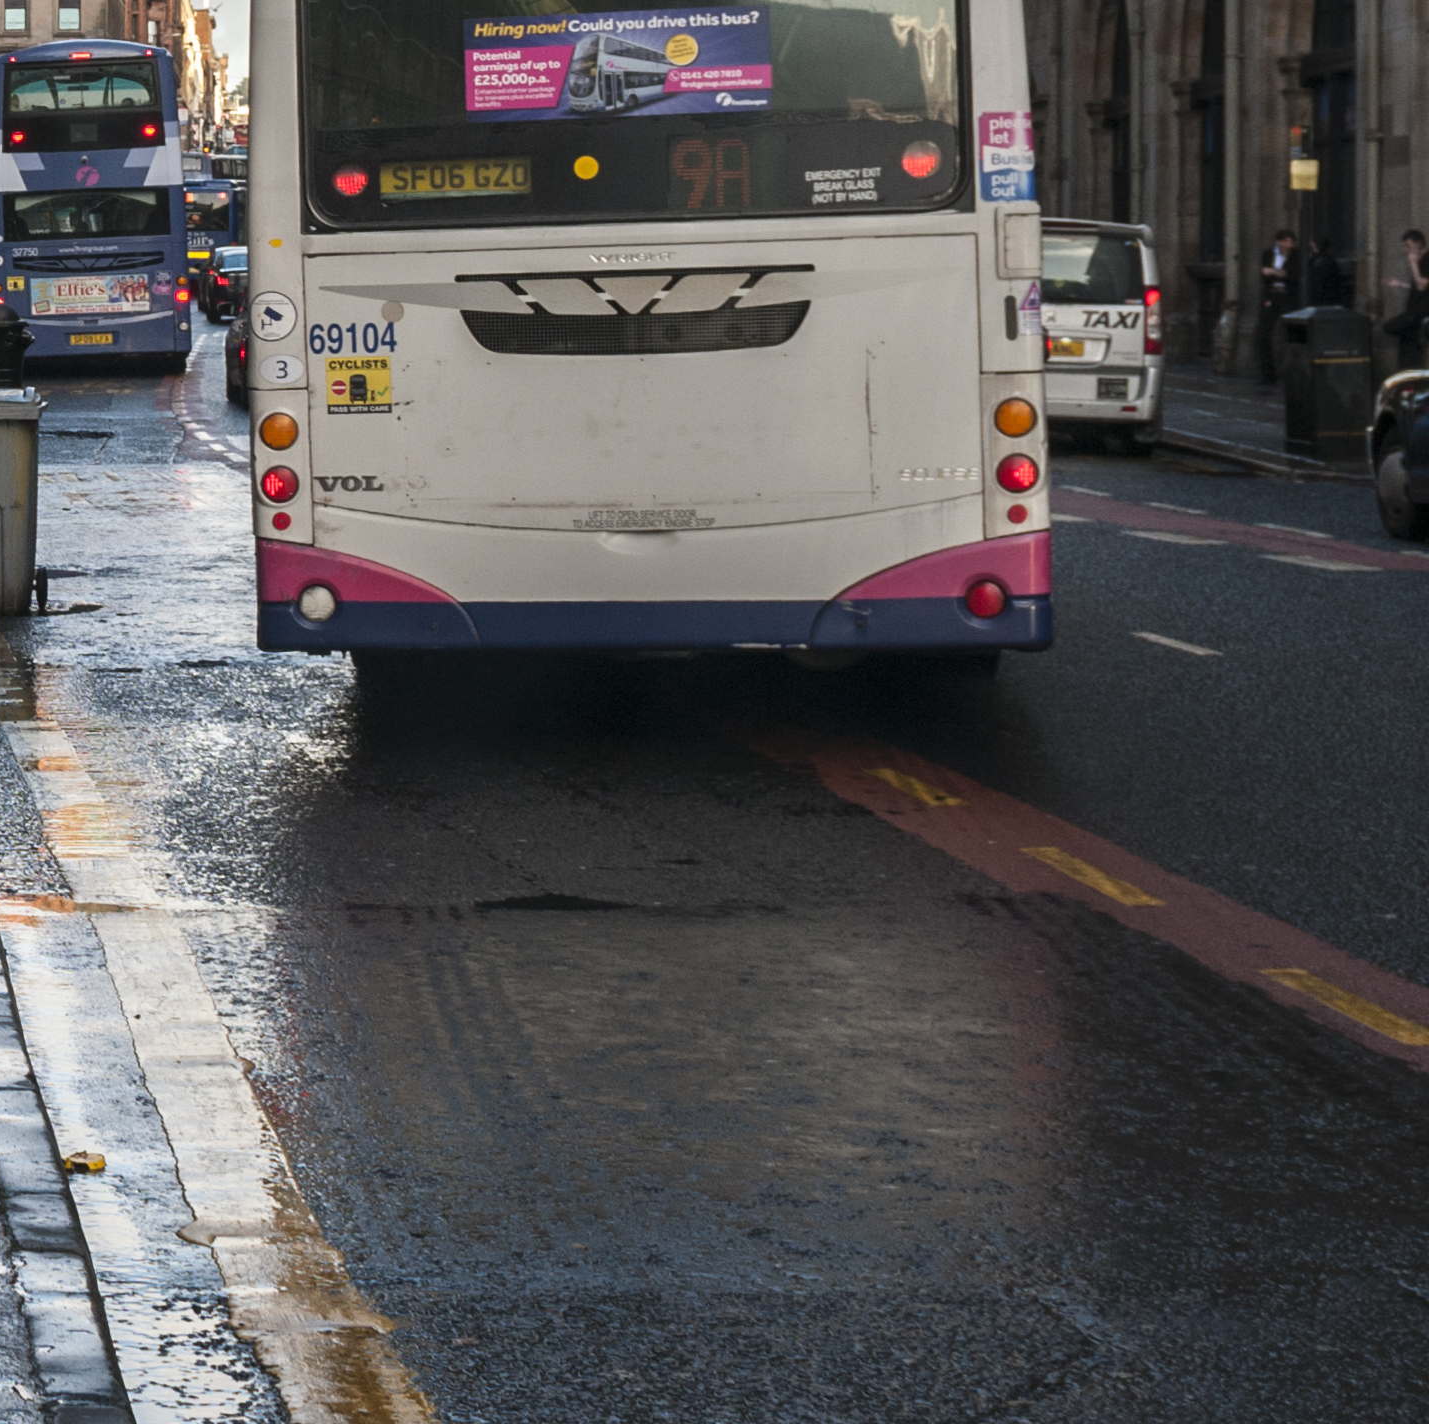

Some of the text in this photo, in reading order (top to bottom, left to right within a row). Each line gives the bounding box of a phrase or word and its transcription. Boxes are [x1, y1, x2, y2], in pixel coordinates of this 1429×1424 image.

[474, 11, 759, 39] Hiring now! Could you drive this bus?
[473, 51, 521, 61] Potential
[473, 60, 561, 73] earnings of up to
[473, 73, 550, 86] £25,000 p.a.
[989, 131, 1009, 144] let
[393, 164, 465, 191] SF06
[673, 139, 750, 208] 9A
[804, 167, 881, 181] EMERGENCY EXIT
[991, 172, 1018, 186] pull
[813, 179, 875, 192] BREAK GLASS
[991, 185, 1016, 197] out
[812, 190, 878, 205] (NOT BY HAND)
[12, 248, 38, 257] 37750
[57, 284, 106, 296] Elfie's
[1082, 310, 1140, 329] TAXI
[309, 322, 397, 354] 69104
[276, 360, 288, 379] 3
[328, 359, 388, 370] CYCLISTS
[588, 509, 697, 519] LIFT TO OPEN SERVICE DOOR
[572, 517, 715, 528] TO ACCESS EMERGENCY ENGINE STOP
